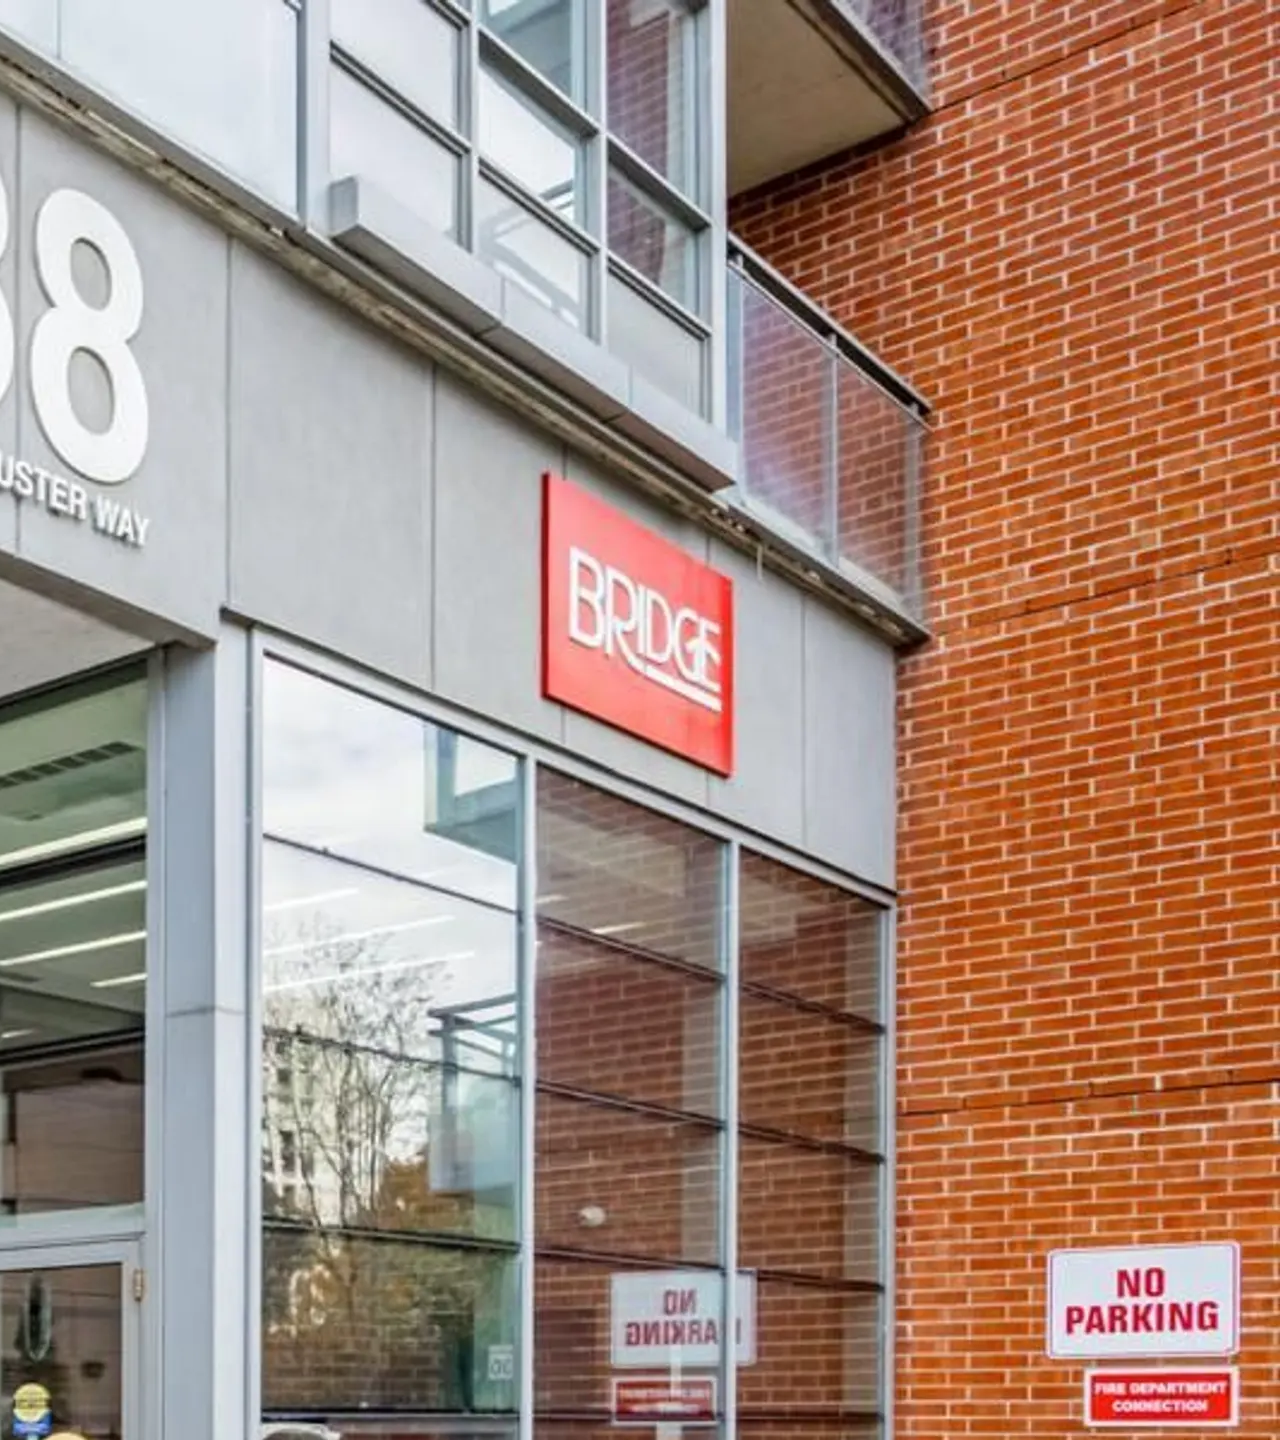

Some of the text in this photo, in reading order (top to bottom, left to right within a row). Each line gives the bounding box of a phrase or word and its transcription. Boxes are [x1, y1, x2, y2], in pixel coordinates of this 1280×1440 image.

[94, 495, 150, 546] WAY
[568, 546, 723, 712] BRIDGE
[1116, 1267, 1166, 1298] NO
[1065, 1300, 1220, 1335] PARKING
[1095, 1381, 1227, 1395] FIRE DEPARTMENT
[1112, 1399, 1209, 1413] CONNECTION
